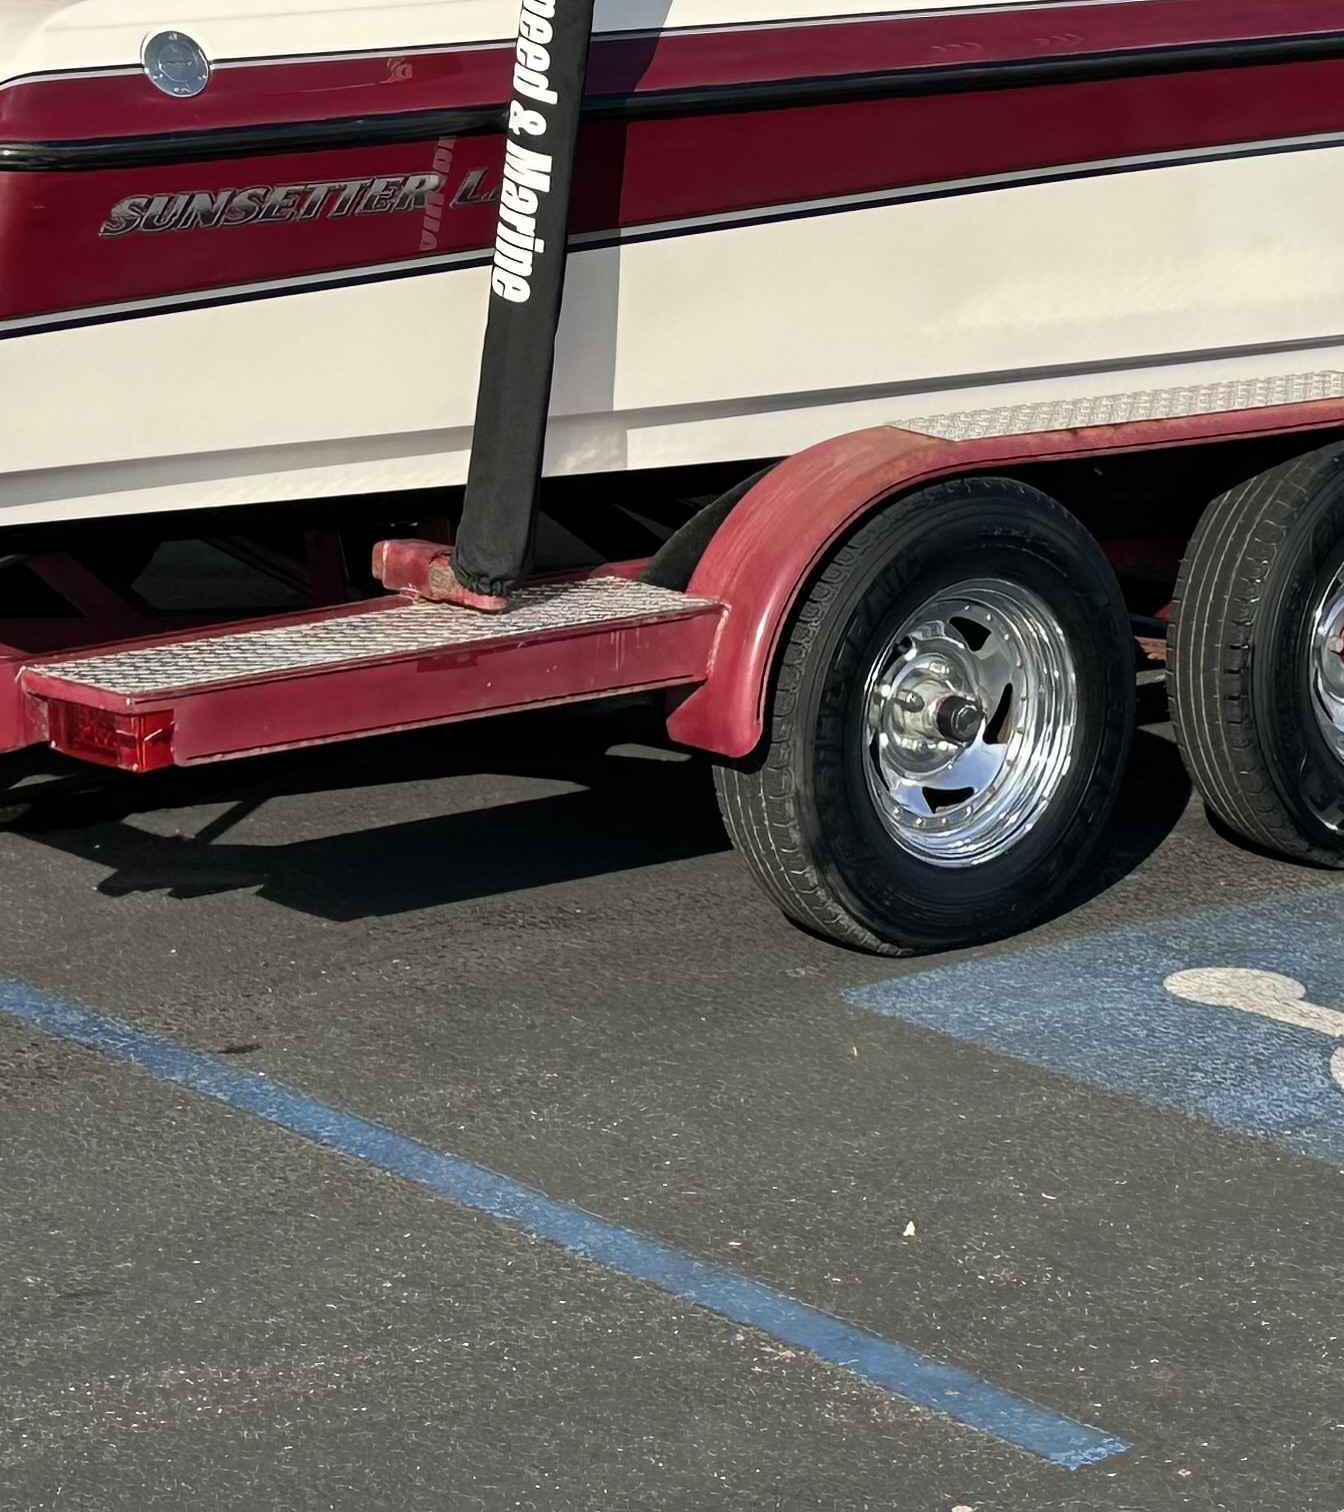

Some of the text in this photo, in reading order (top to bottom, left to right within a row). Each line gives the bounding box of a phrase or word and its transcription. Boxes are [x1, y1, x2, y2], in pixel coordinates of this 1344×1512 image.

[508, 99, 547, 136] &
[98, 172, 442, 238] SUNSETTER
[491, 137, 553, 304] Marine
